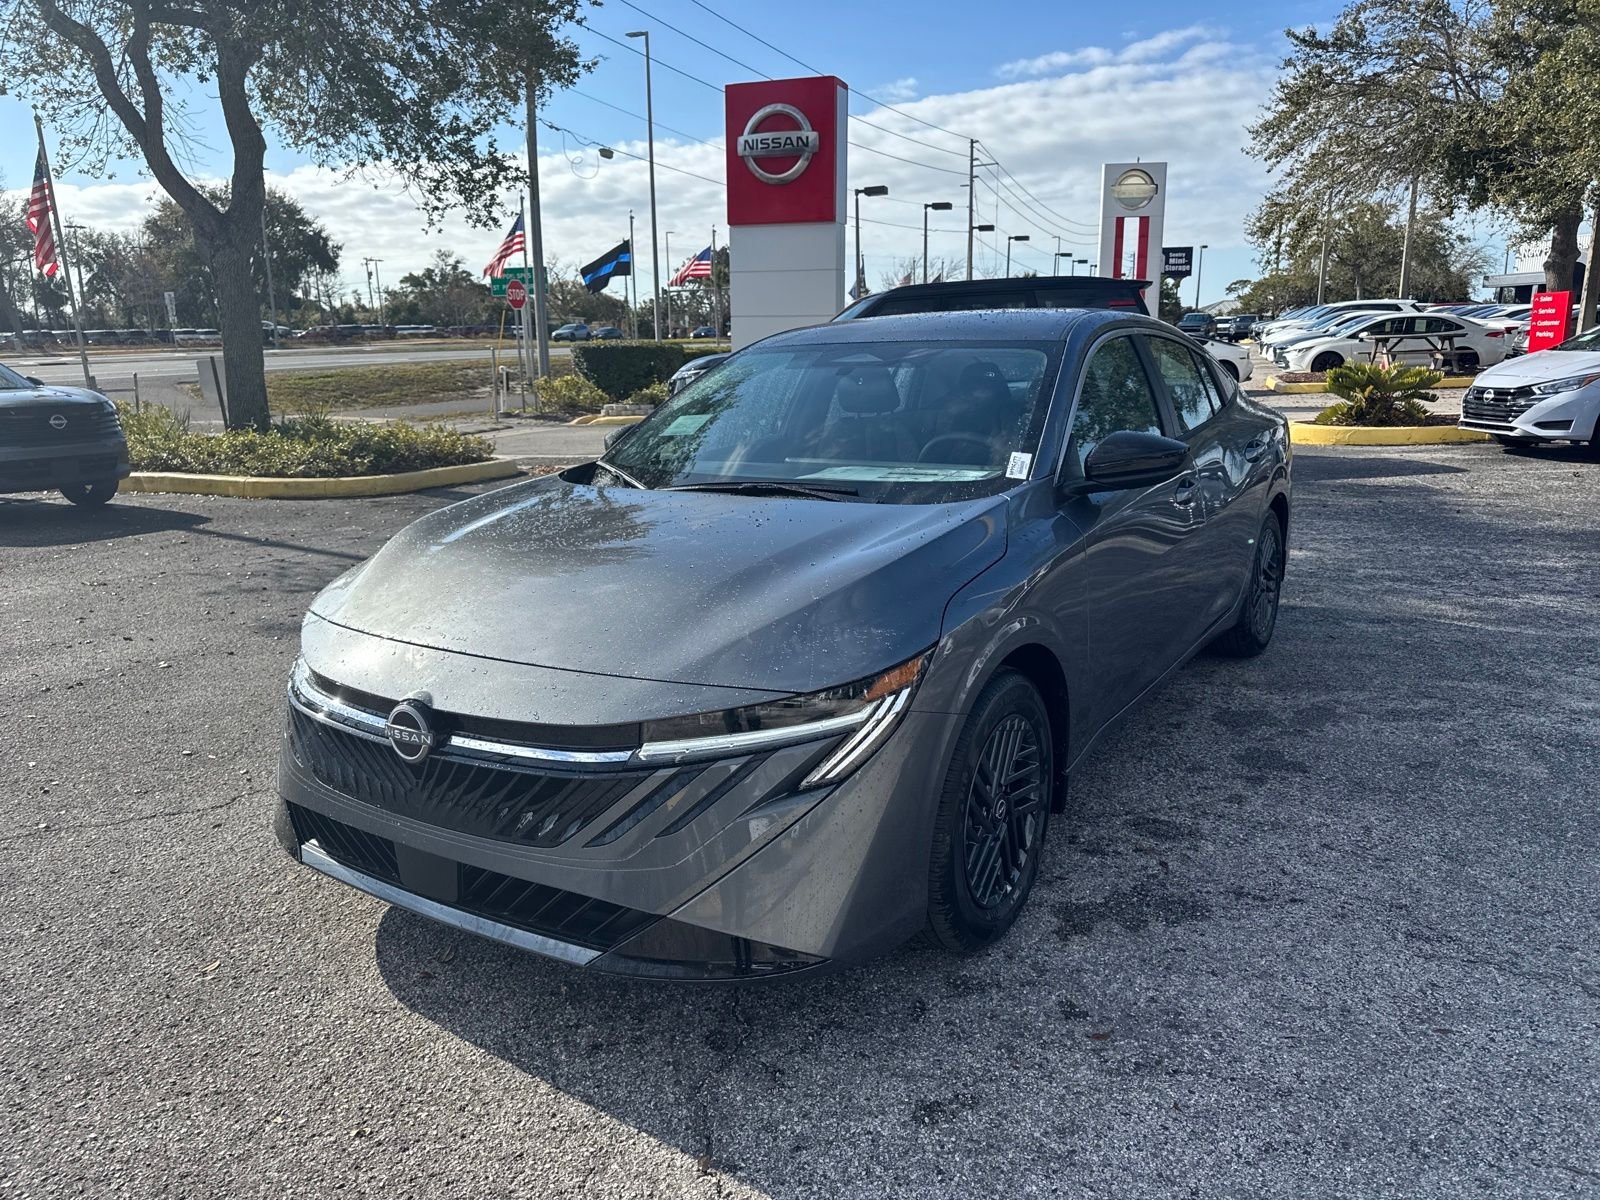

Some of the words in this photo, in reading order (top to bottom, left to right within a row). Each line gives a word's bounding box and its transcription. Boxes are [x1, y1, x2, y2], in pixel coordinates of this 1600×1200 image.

[743, 135, 809, 151] NISSAN
[508, 289, 525, 300] STOP
[385, 724, 431, 744] NISSAN
